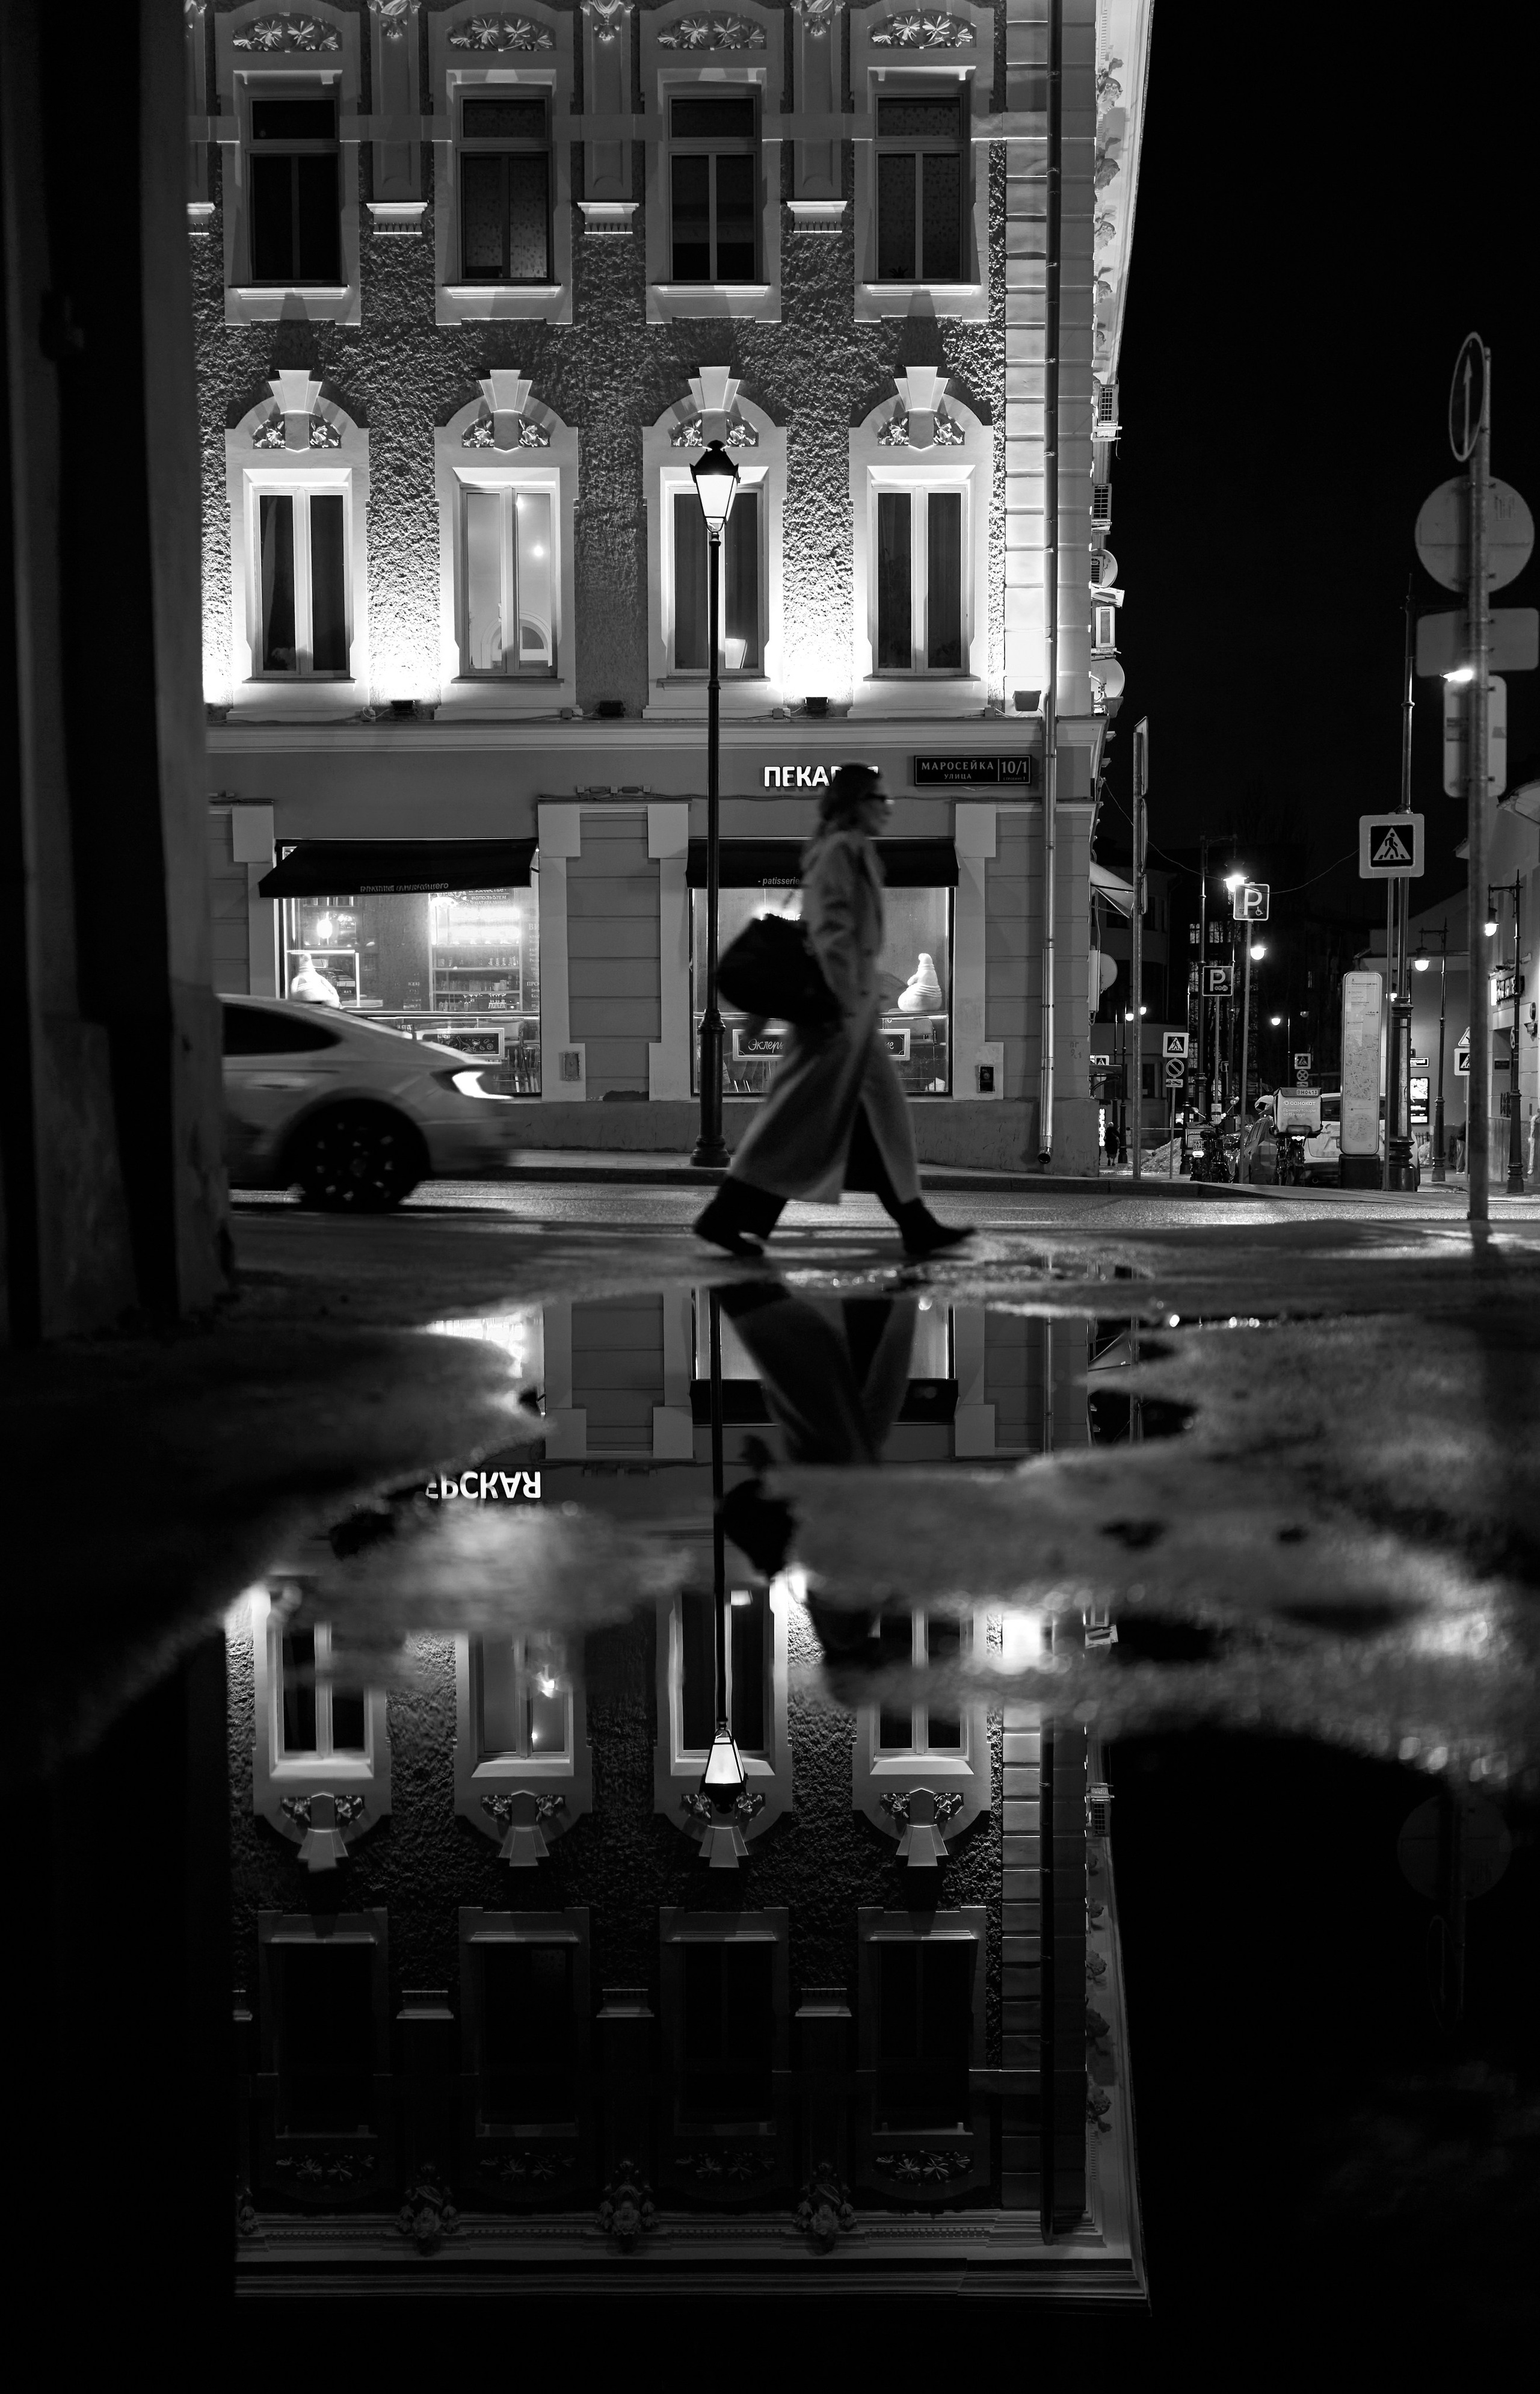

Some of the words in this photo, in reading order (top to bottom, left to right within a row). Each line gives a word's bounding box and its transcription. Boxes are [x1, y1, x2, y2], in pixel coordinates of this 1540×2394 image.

[764, 765, 878, 787] ПЕКА
[922, 760, 994, 770] МАРОСЕЙКА
[1001, 760, 1027, 775] 10/1
[762, 877, 800, 886] patisserie
[1210, 969, 1226, 992] P
